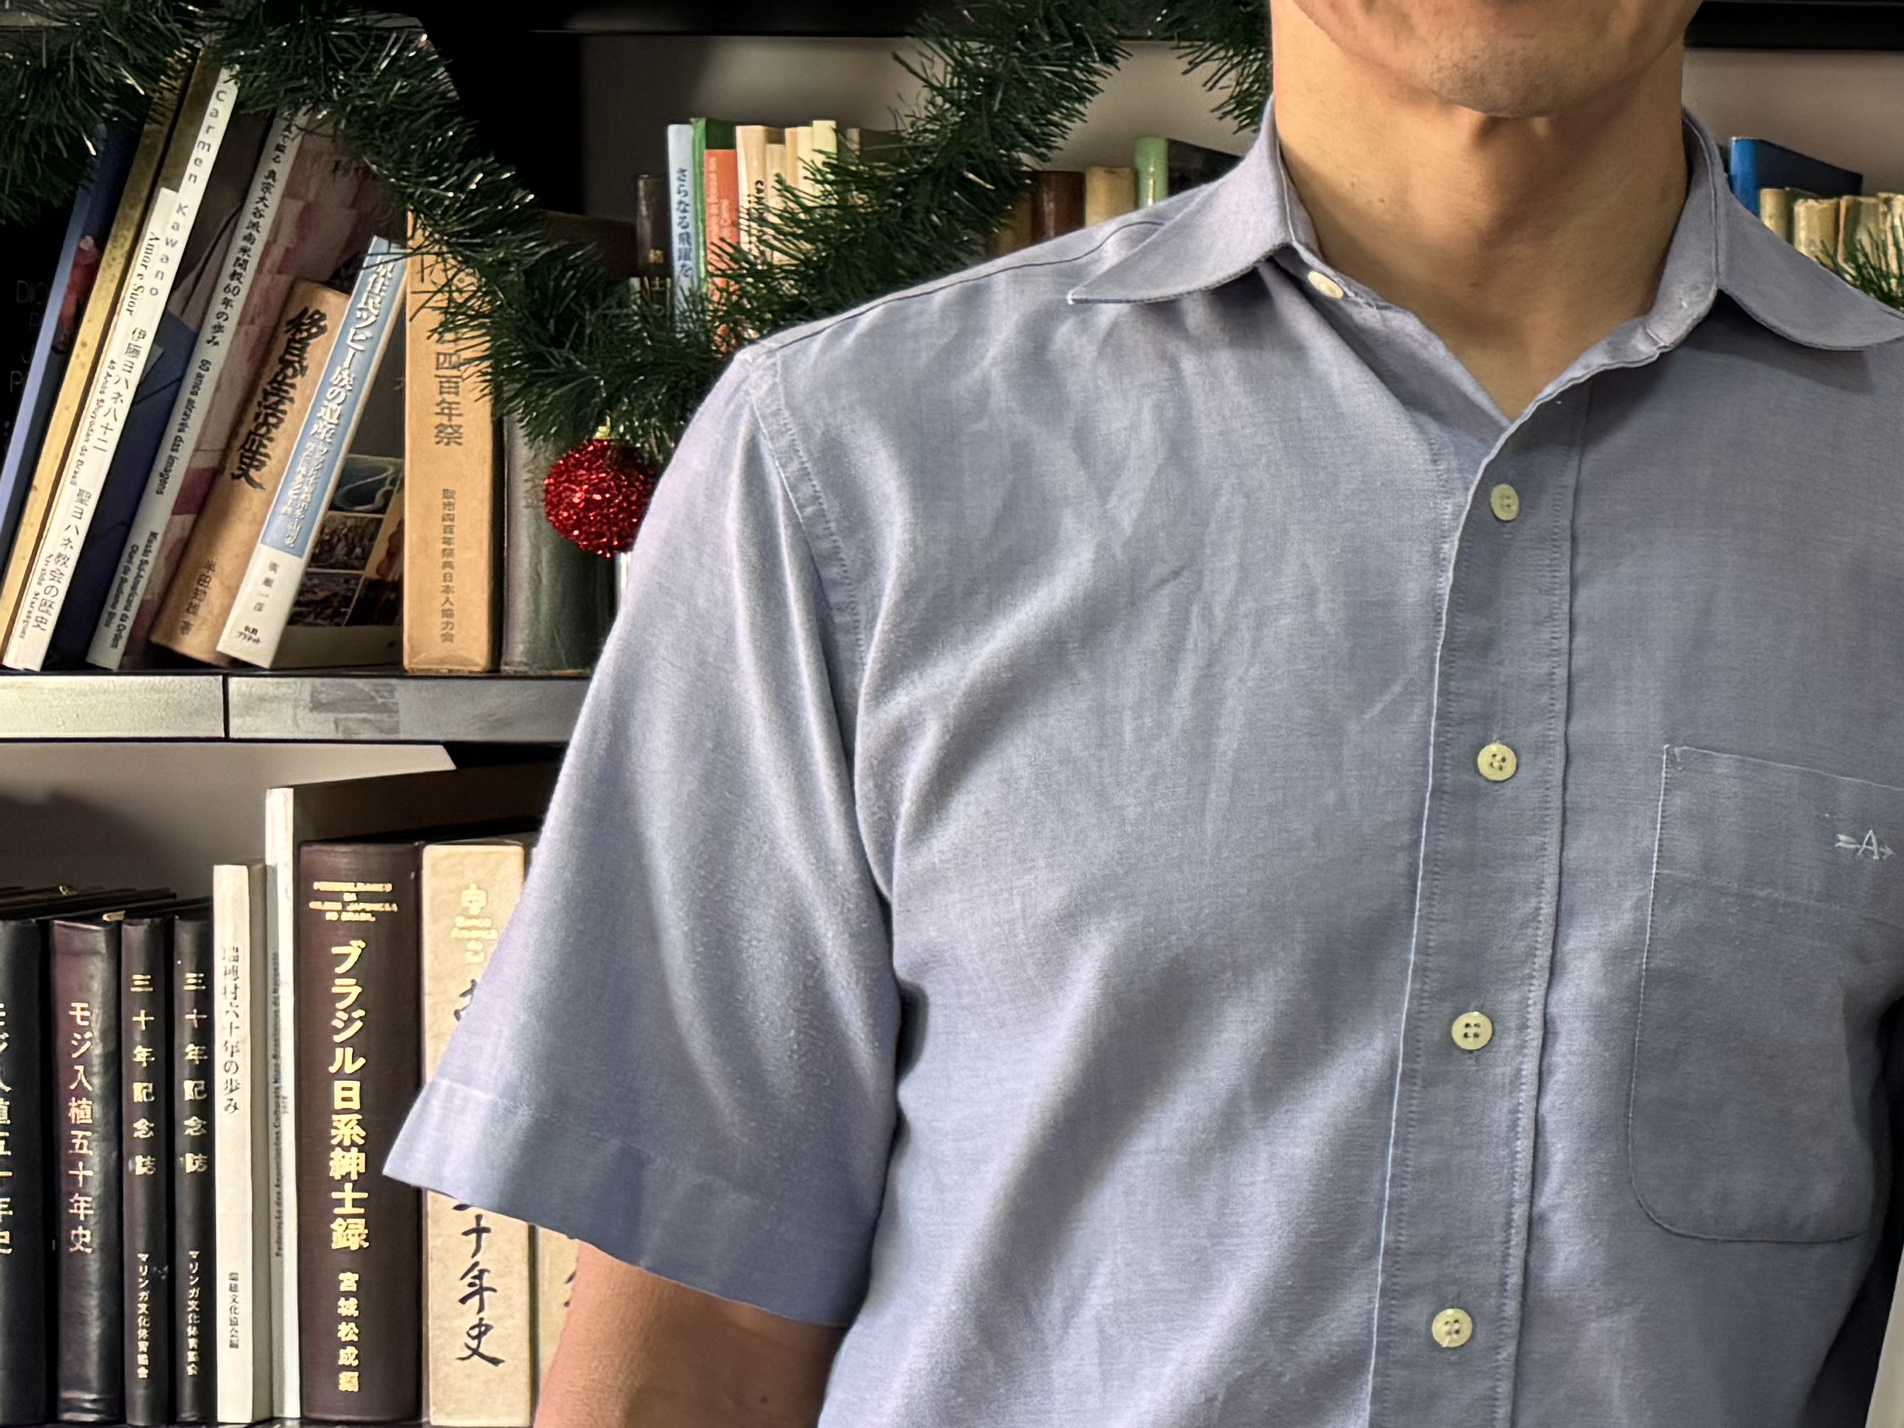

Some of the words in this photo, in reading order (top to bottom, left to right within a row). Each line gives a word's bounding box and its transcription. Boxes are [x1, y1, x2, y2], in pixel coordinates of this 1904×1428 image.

[187, 88, 229, 184] Carmen
[148, 203, 189, 298] Kawano
[231, 306, 328, 491] 移民生活の歴史
[65, 1001, 95, 1255] モジ入植五十年史
[129, 973, 157, 1177] 三十年記念誌
[182, 972, 209, 1174] 三十年記念誌
[328, 939, 370, 1252] ブラジル日系紳士録
